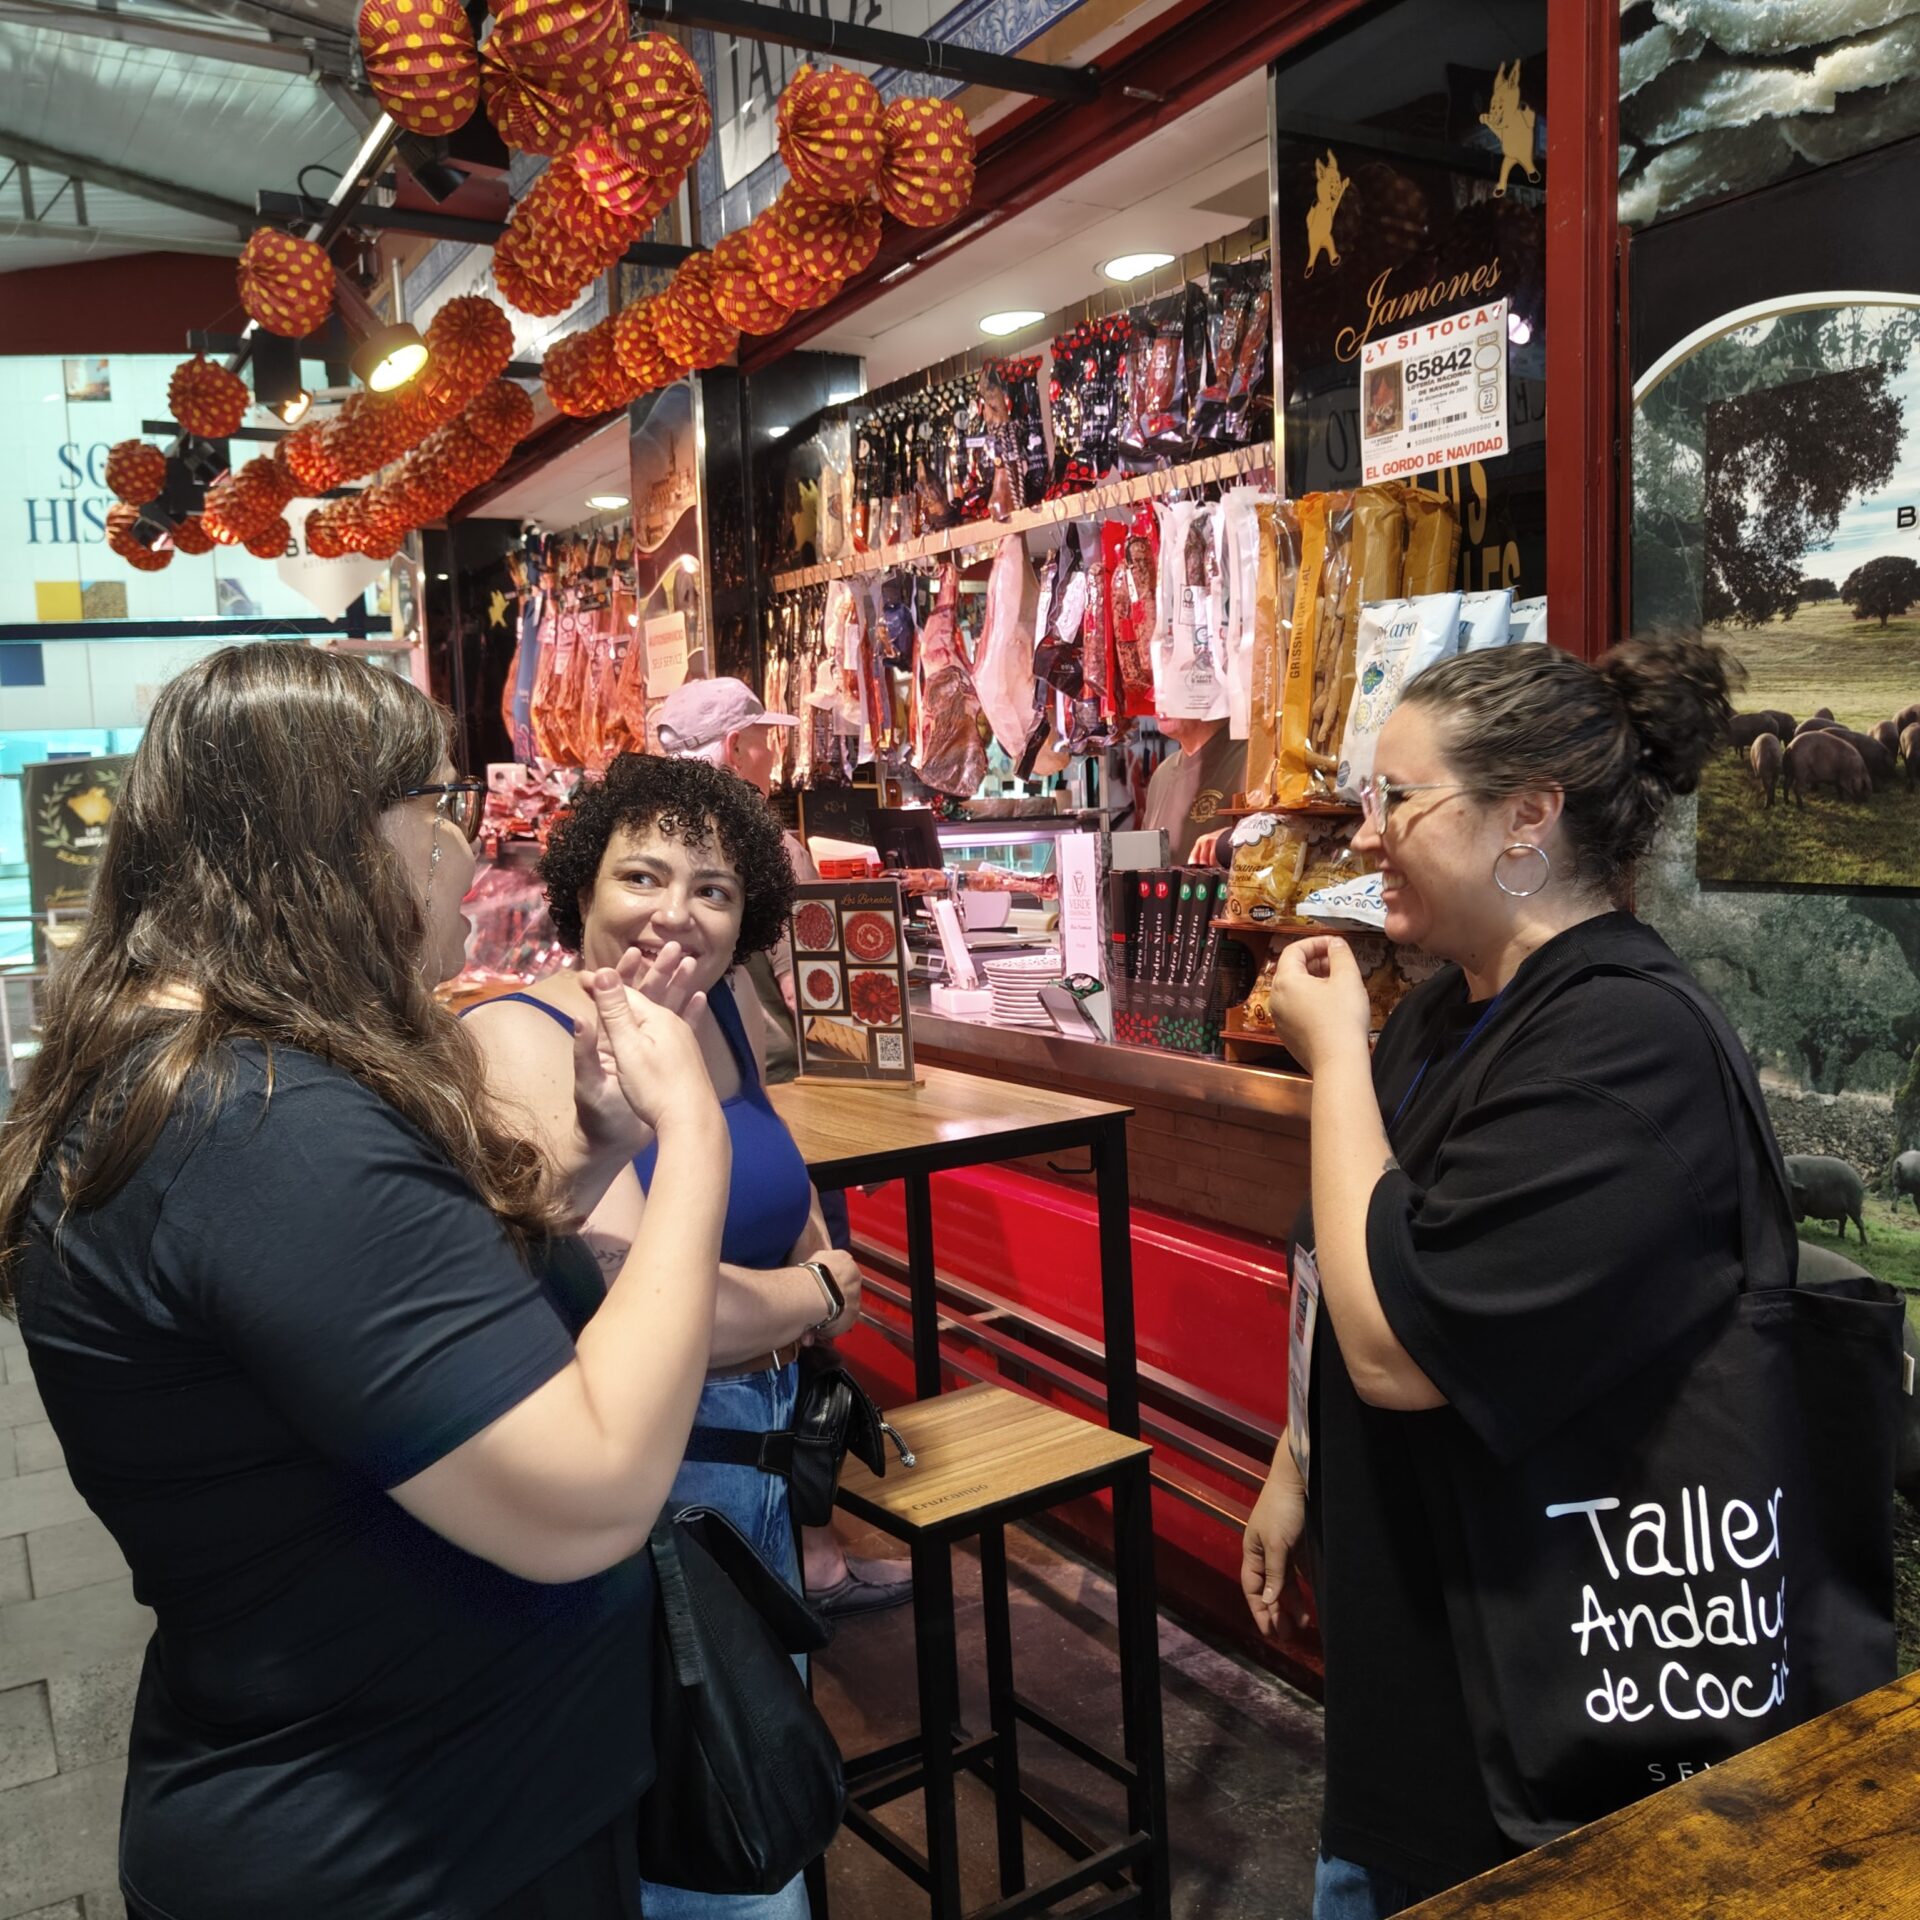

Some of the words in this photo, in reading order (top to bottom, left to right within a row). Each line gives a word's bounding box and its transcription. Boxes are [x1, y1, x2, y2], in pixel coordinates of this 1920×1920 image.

[1335, 257, 1501, 362] Jamones
[1364, 341, 1388, 364] ¿Y
[1397, 332, 1418, 350] SI
[1405, 347, 1472, 383] 65842
[1407, 379, 1435, 391] LOTERÍA
[1437, 370, 1472, 382] NACIONAL
[1425, 392, 1448, 402] diciembre
[1429, 381, 1460, 394] NAVIDAD
[1484, 393, 1493, 405] 22
[1366, 467, 1380, 480] EL
[1382, 455, 1424, 476] GORDO
[1427, 451, 1443, 465] DE
[1446, 436, 1503, 460] NAVIDAD
[24, 497, 119, 545] HIS
[1137, 912, 1145, 943] Nieto
[1153, 912, 1163, 944] Nieto
[1134, 949, 1143, 983] Pedro
[1152, 950, 1161, 985] Pedro
[1167, 951, 1178, 986] Pedro
[1173, 914, 1183, 946] Nieto
[1183, 952, 1194, 987] Pedro
[1189, 914, 1199, 947] Nieto
[1199, 952, 1211, 987] Pedro
[911, 1483, 988, 1511] Cruzcampo
[1546, 1485, 1783, 1580] Taller
[1586, 1668, 1654, 1723] de
